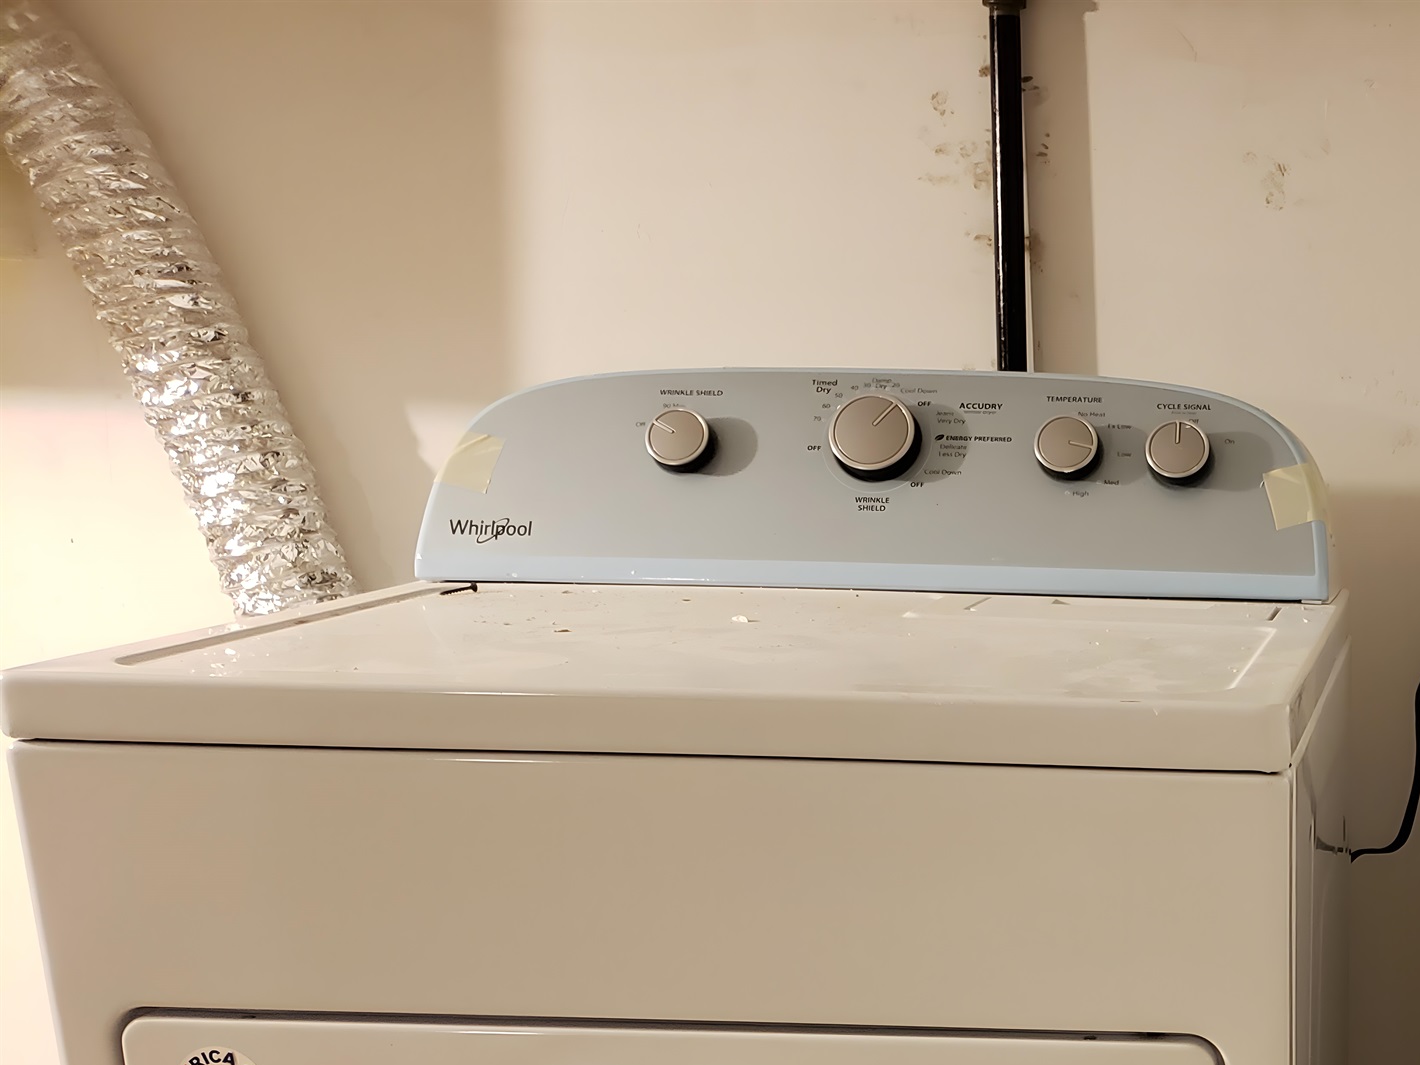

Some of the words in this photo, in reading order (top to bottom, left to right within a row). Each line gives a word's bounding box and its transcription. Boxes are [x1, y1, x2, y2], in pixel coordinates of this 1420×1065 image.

[695, 389, 724, 397] SHIELD
[816, 386, 832, 394] Dry
[1046, 395, 1103, 404] TEMPERATURE
[959, 402, 1003, 410] ACCUDRY
[1156, 403, 1182, 411] CYCLE
[1183, 403, 1211, 411] SIGNAL
[1072, 490, 1089, 498] High
[855, 496, 890, 505] WRINKLE
[449, 517, 533, 544] Whirlpool
